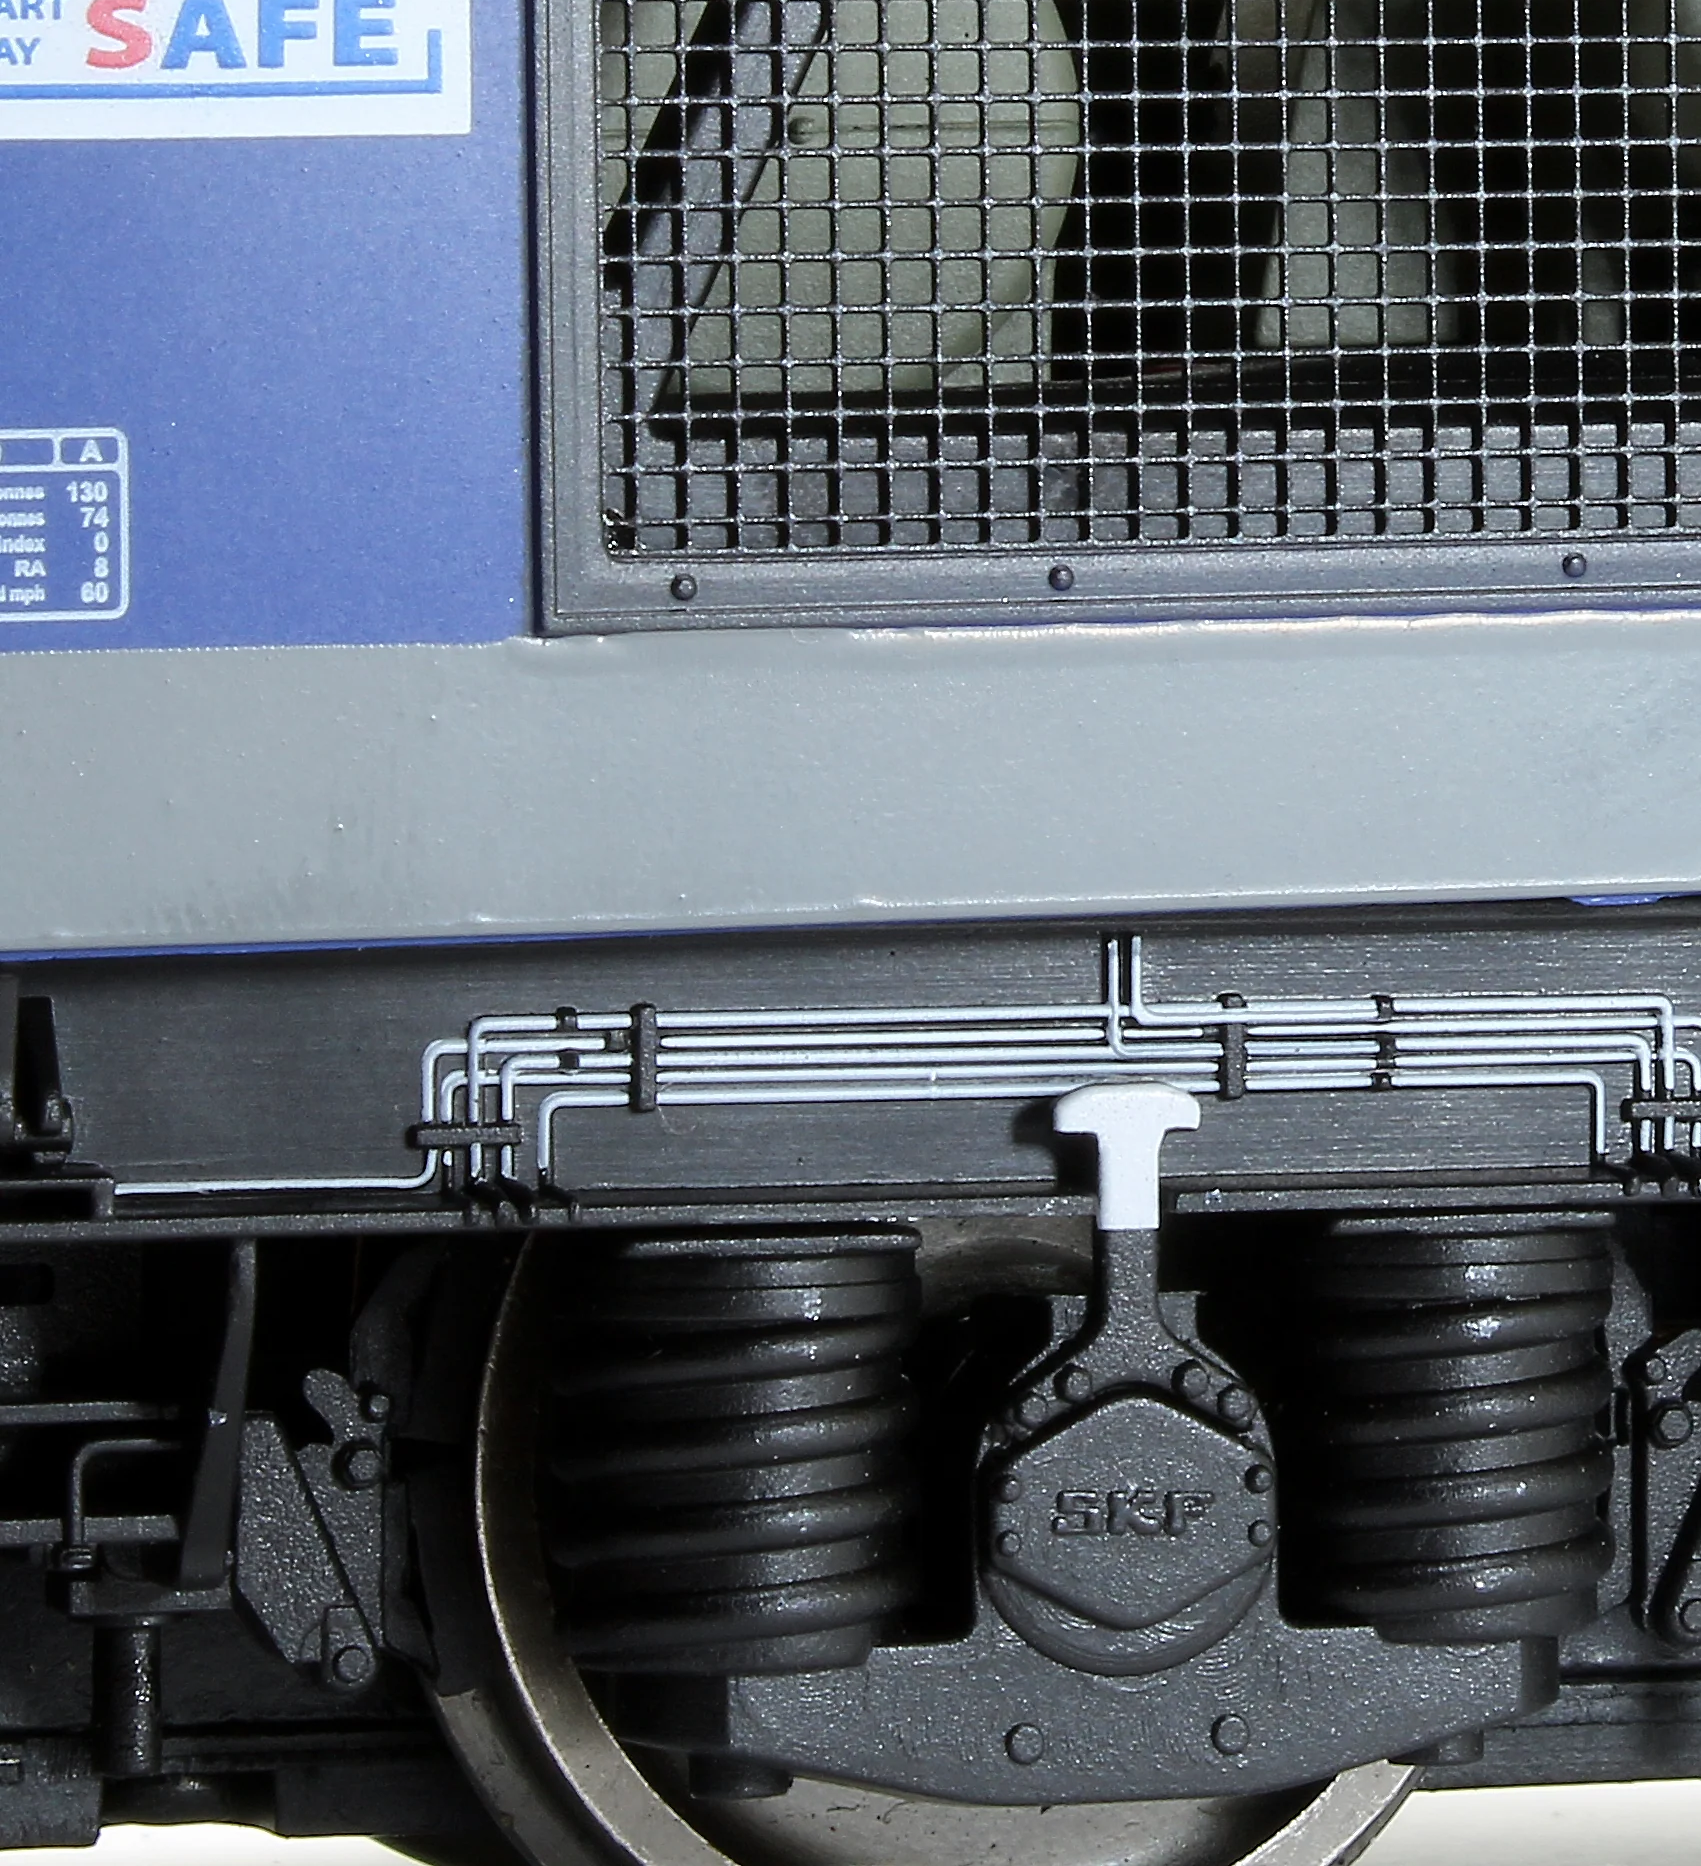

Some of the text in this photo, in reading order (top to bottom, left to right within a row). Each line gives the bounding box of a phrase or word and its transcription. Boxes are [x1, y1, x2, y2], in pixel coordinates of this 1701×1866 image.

[0, 37, 41, 66] AY
[79, 439, 103, 462] A
[66, 481, 109, 503] 130
[79, 506, 109, 528] 74
[14, 556, 109, 578] RA 8
[9, 583, 46, 606] mph
[80, 581, 109, 604] 60
[1052, 1489, 1216, 1536] SKF
